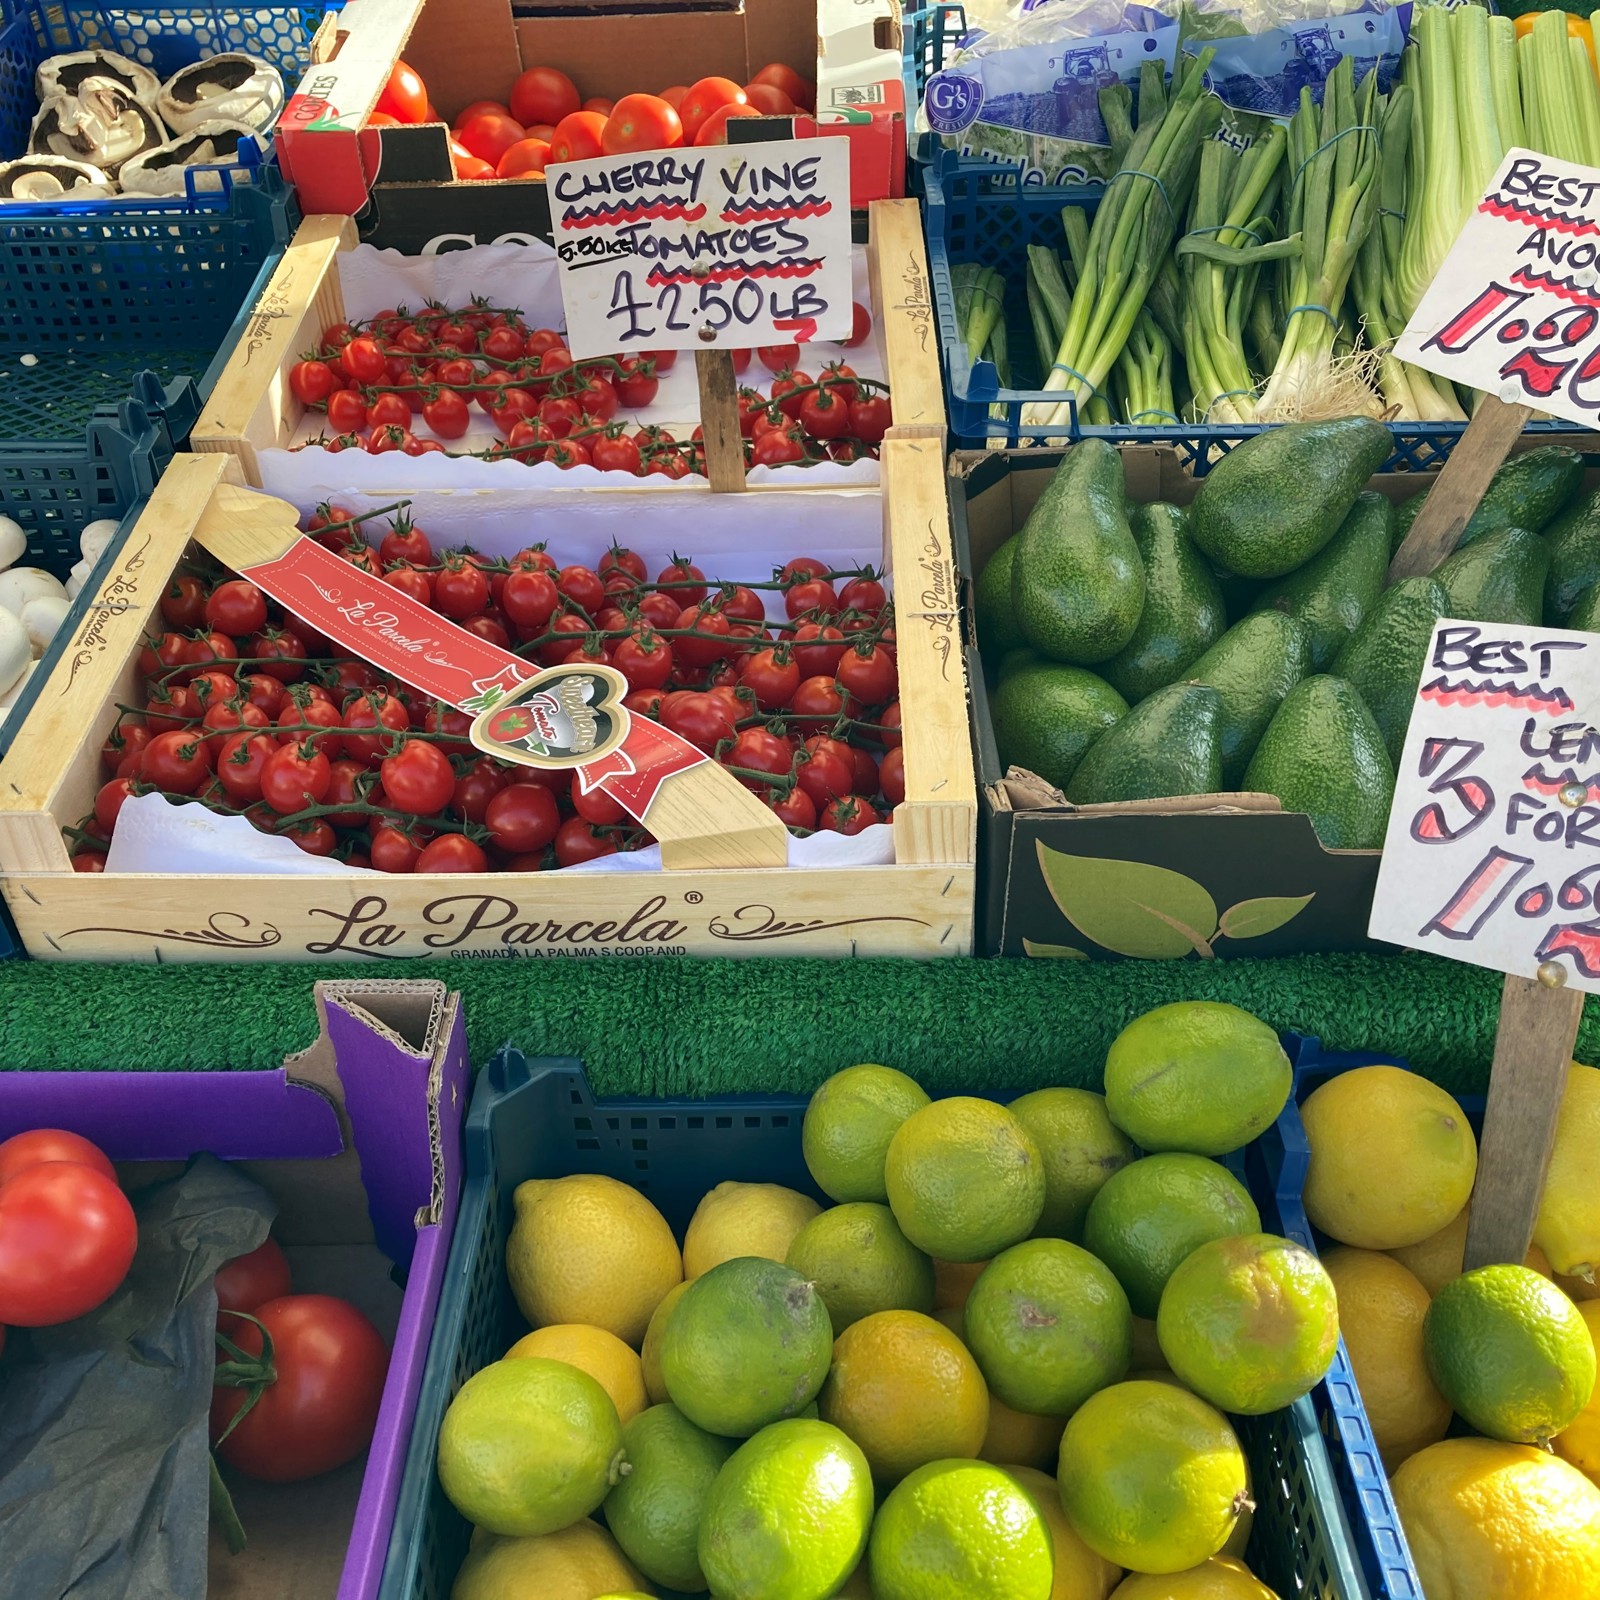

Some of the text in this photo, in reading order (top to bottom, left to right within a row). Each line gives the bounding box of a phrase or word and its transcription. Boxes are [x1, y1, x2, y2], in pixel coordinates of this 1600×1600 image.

[294, 75, 339, 120] CORTES
[931, 82, 967, 110] G's
[932, 119, 965, 131] FRESH
[555, 156, 822, 203] CHERRY VINE
[1500, 159, 1600, 208] BEST
[615, 219, 810, 260] TOMATOES
[1516, 228, 1600, 271] AVO
[103, 575, 138, 599] La
[337, 599, 376, 626] La
[1432, 627, 1588, 679] BEST
[521, 692, 560, 744] Tomato
[1410, 737, 1600, 849] 3 FOR
[306, 895, 432, 960] La
[450, 948, 522, 960] GRANADA
[525, 948, 545, 959] LA
[547, 947, 596, 958] PALMA
